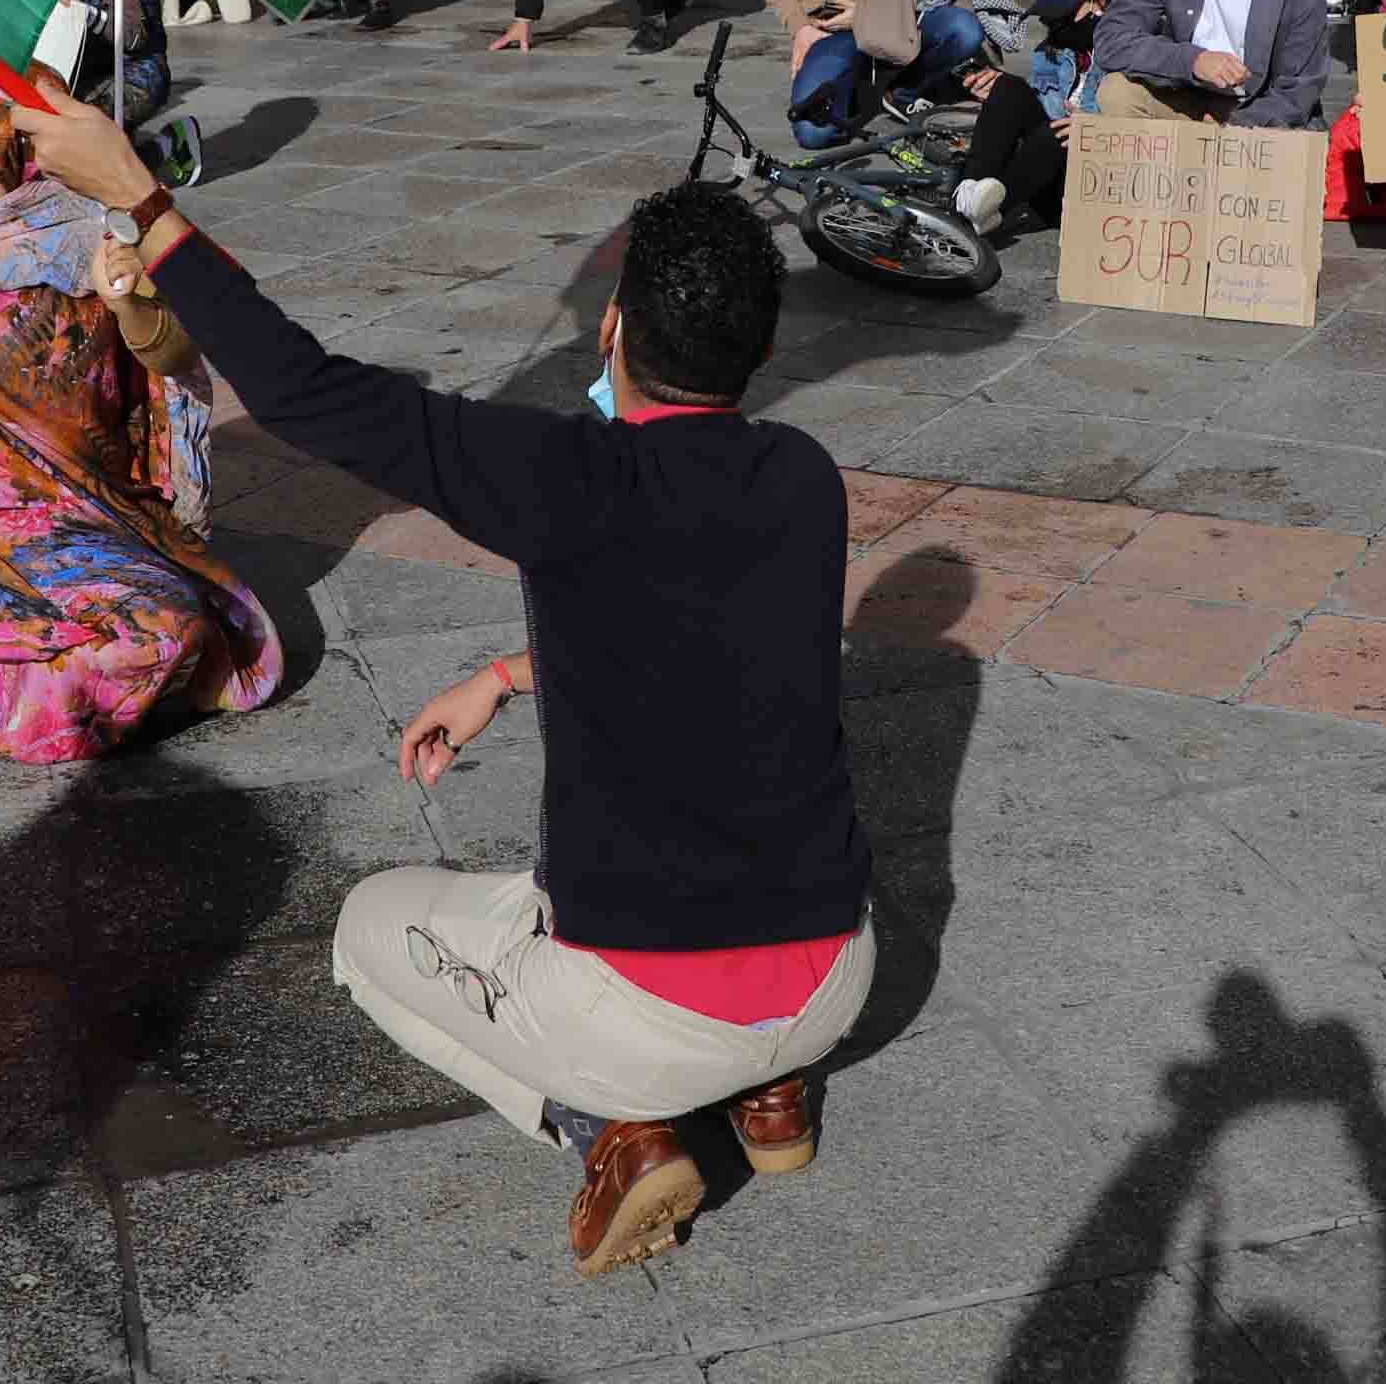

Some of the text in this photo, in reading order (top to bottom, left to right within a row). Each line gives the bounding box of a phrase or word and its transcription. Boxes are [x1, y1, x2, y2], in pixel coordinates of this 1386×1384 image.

[1079, 124, 1277, 171] ESPAÑA TIENE
[1218, 193, 1291, 223] CON EL
[1099, 216, 1193, 286] SUR
[1216, 235, 1294, 267] GLOBAL
